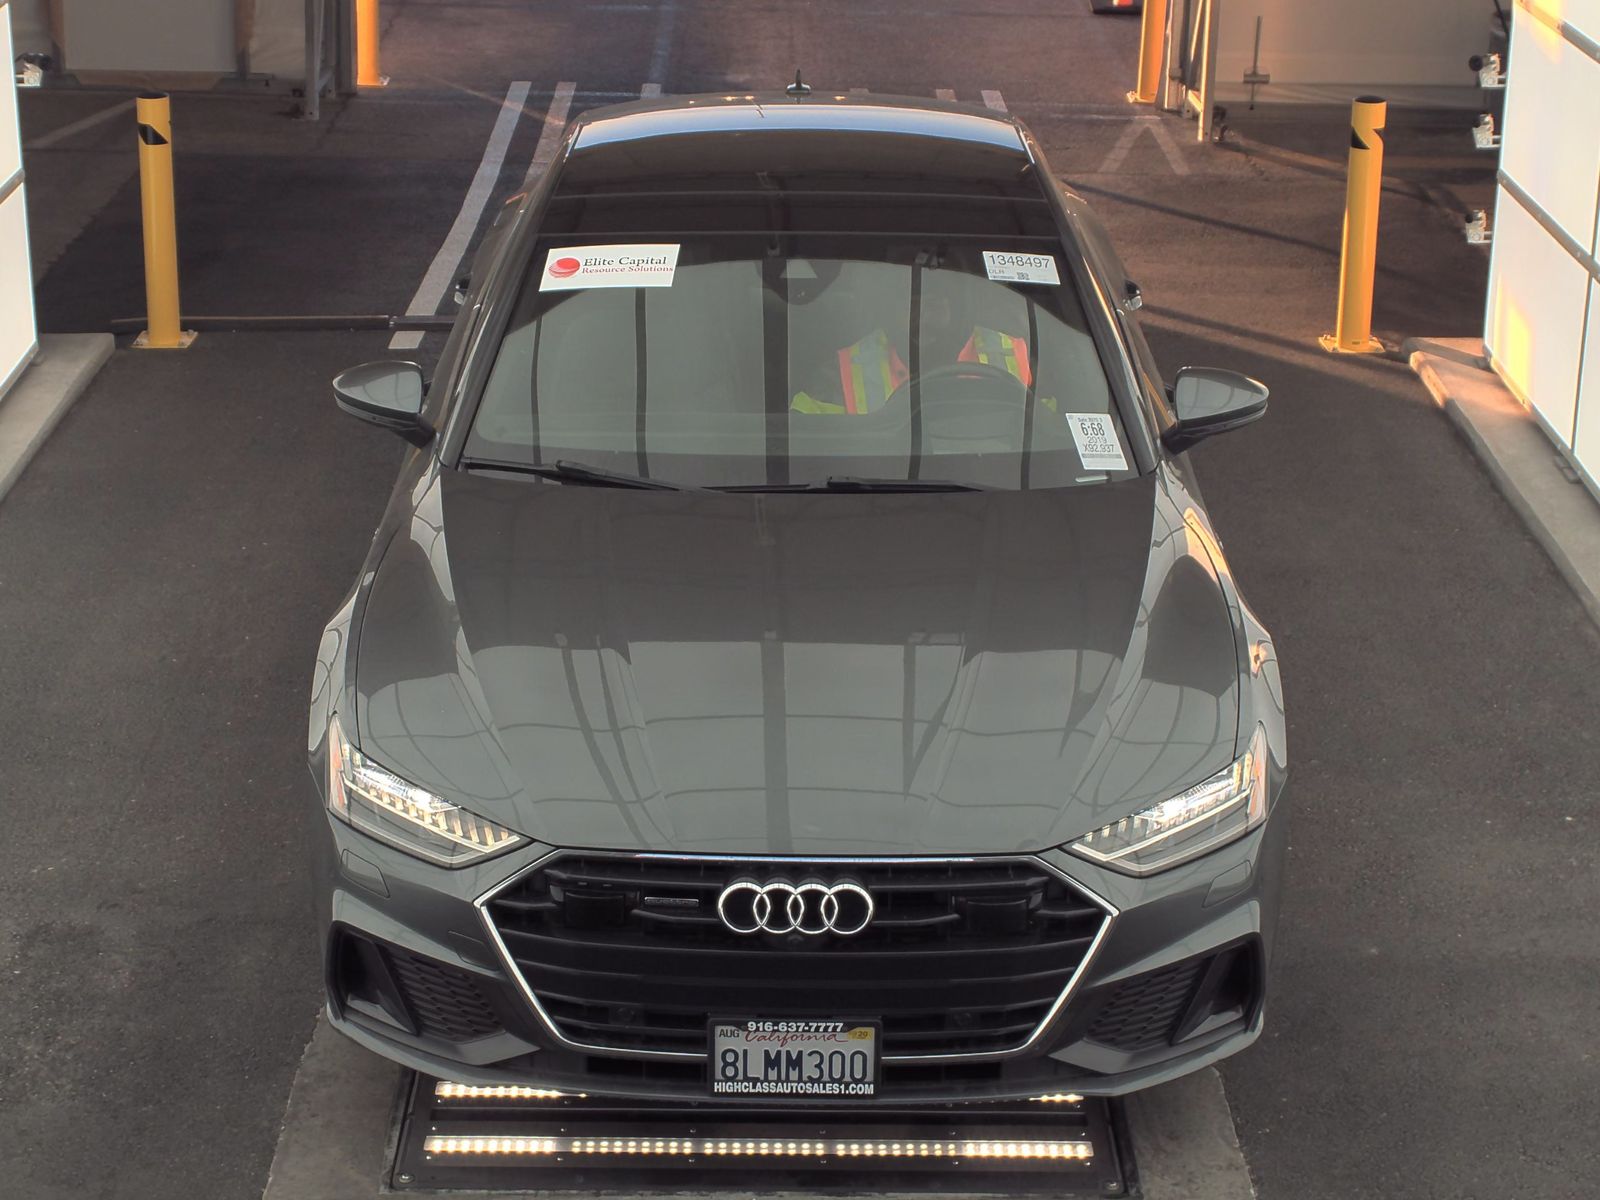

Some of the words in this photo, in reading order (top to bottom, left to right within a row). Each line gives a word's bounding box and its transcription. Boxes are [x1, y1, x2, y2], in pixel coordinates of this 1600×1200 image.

[583, 258, 614, 267] Elite
[619, 256, 667, 267] Capital
[989, 254, 1050, 268] 1348497
[582, 266, 626, 274] Resource
[628, 265, 674, 273] Solutions
[1087, 436, 1107, 444] 2019
[747, 1021, 844, 1032] 916-637-7777
[719, 1028, 740, 1038] AUG
[745, 1030, 848, 1047] California
[720, 1048, 868, 1083] 8LMM300
[714, 1082, 874, 1094] HIGHCLASSAUTOSALES1.COM
